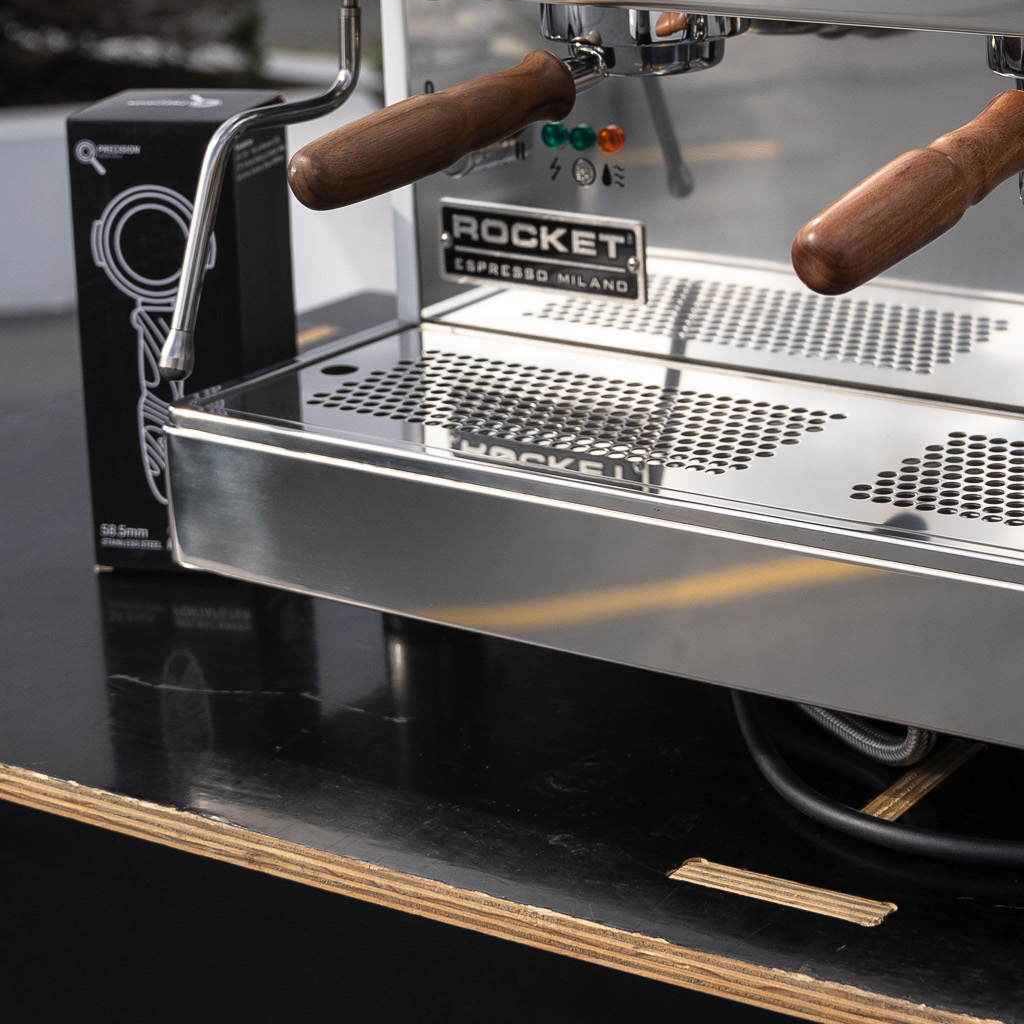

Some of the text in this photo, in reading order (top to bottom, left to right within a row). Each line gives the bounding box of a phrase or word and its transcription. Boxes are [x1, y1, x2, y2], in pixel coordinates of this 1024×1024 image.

[451, 213, 626, 259] ROCKET
[453, 257, 629, 293] ESPRESSO MILANO
